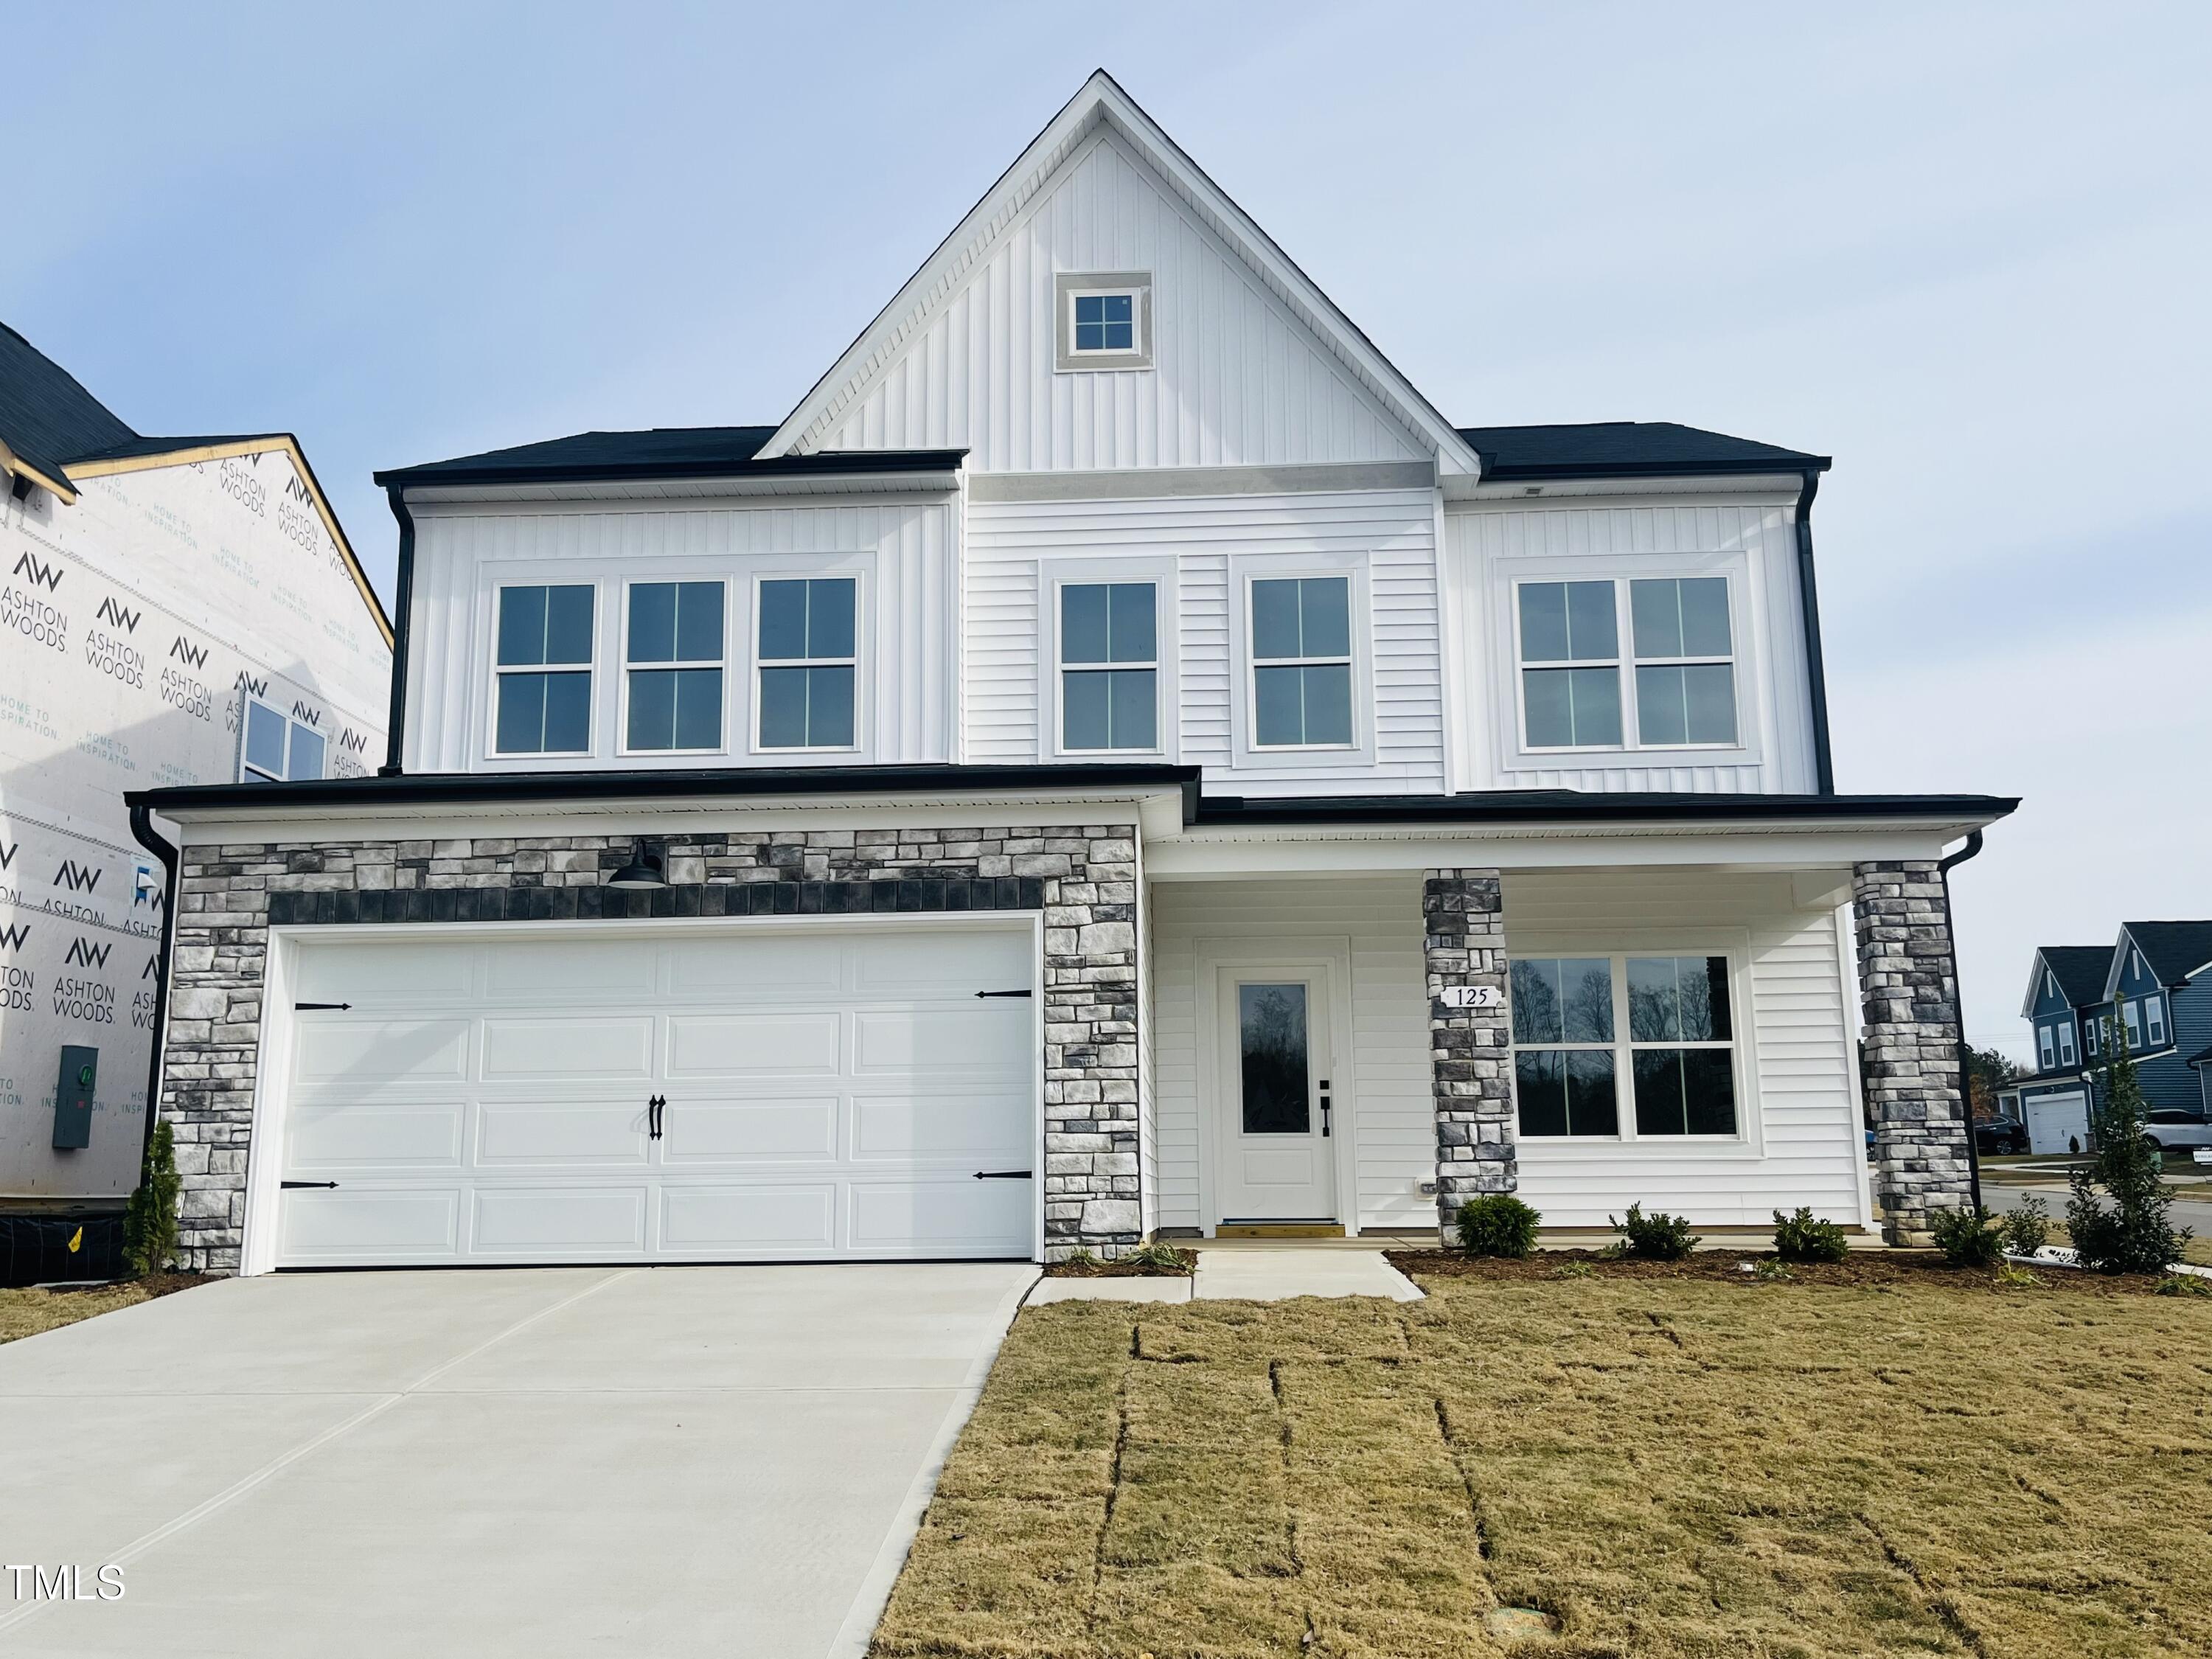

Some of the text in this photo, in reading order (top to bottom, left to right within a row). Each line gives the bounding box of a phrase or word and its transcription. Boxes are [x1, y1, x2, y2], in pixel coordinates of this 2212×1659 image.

[220, 459, 266, 503] ASHTON
[153, 503, 192, 532] HOME TO
[278, 502, 319, 540] ASHTON
[13, 551, 64, 593] AW
[1, 585, 67, 632] ASHTON
[96, 596, 141, 634] AW
[86, 629, 145, 670] ASHTON
[170, 635, 209, 670] AW
[161, 667, 212, 704] ASHTON
[1, 694, 49, 722] HOME TO
[293, 699, 320, 726] AW
[86, 730, 128, 755] HOME TO
[340, 726, 367, 754] AW
[188, 773, 198, 783] TO
[53, 860, 102, 894] AW
[0, 922, 31, 953] W
[65, 936, 112, 970] AW
[1, 966, 35, 989] TON
[55, 977, 115, 1004] ASHTON
[1457, 989, 1488, 1005] 125
